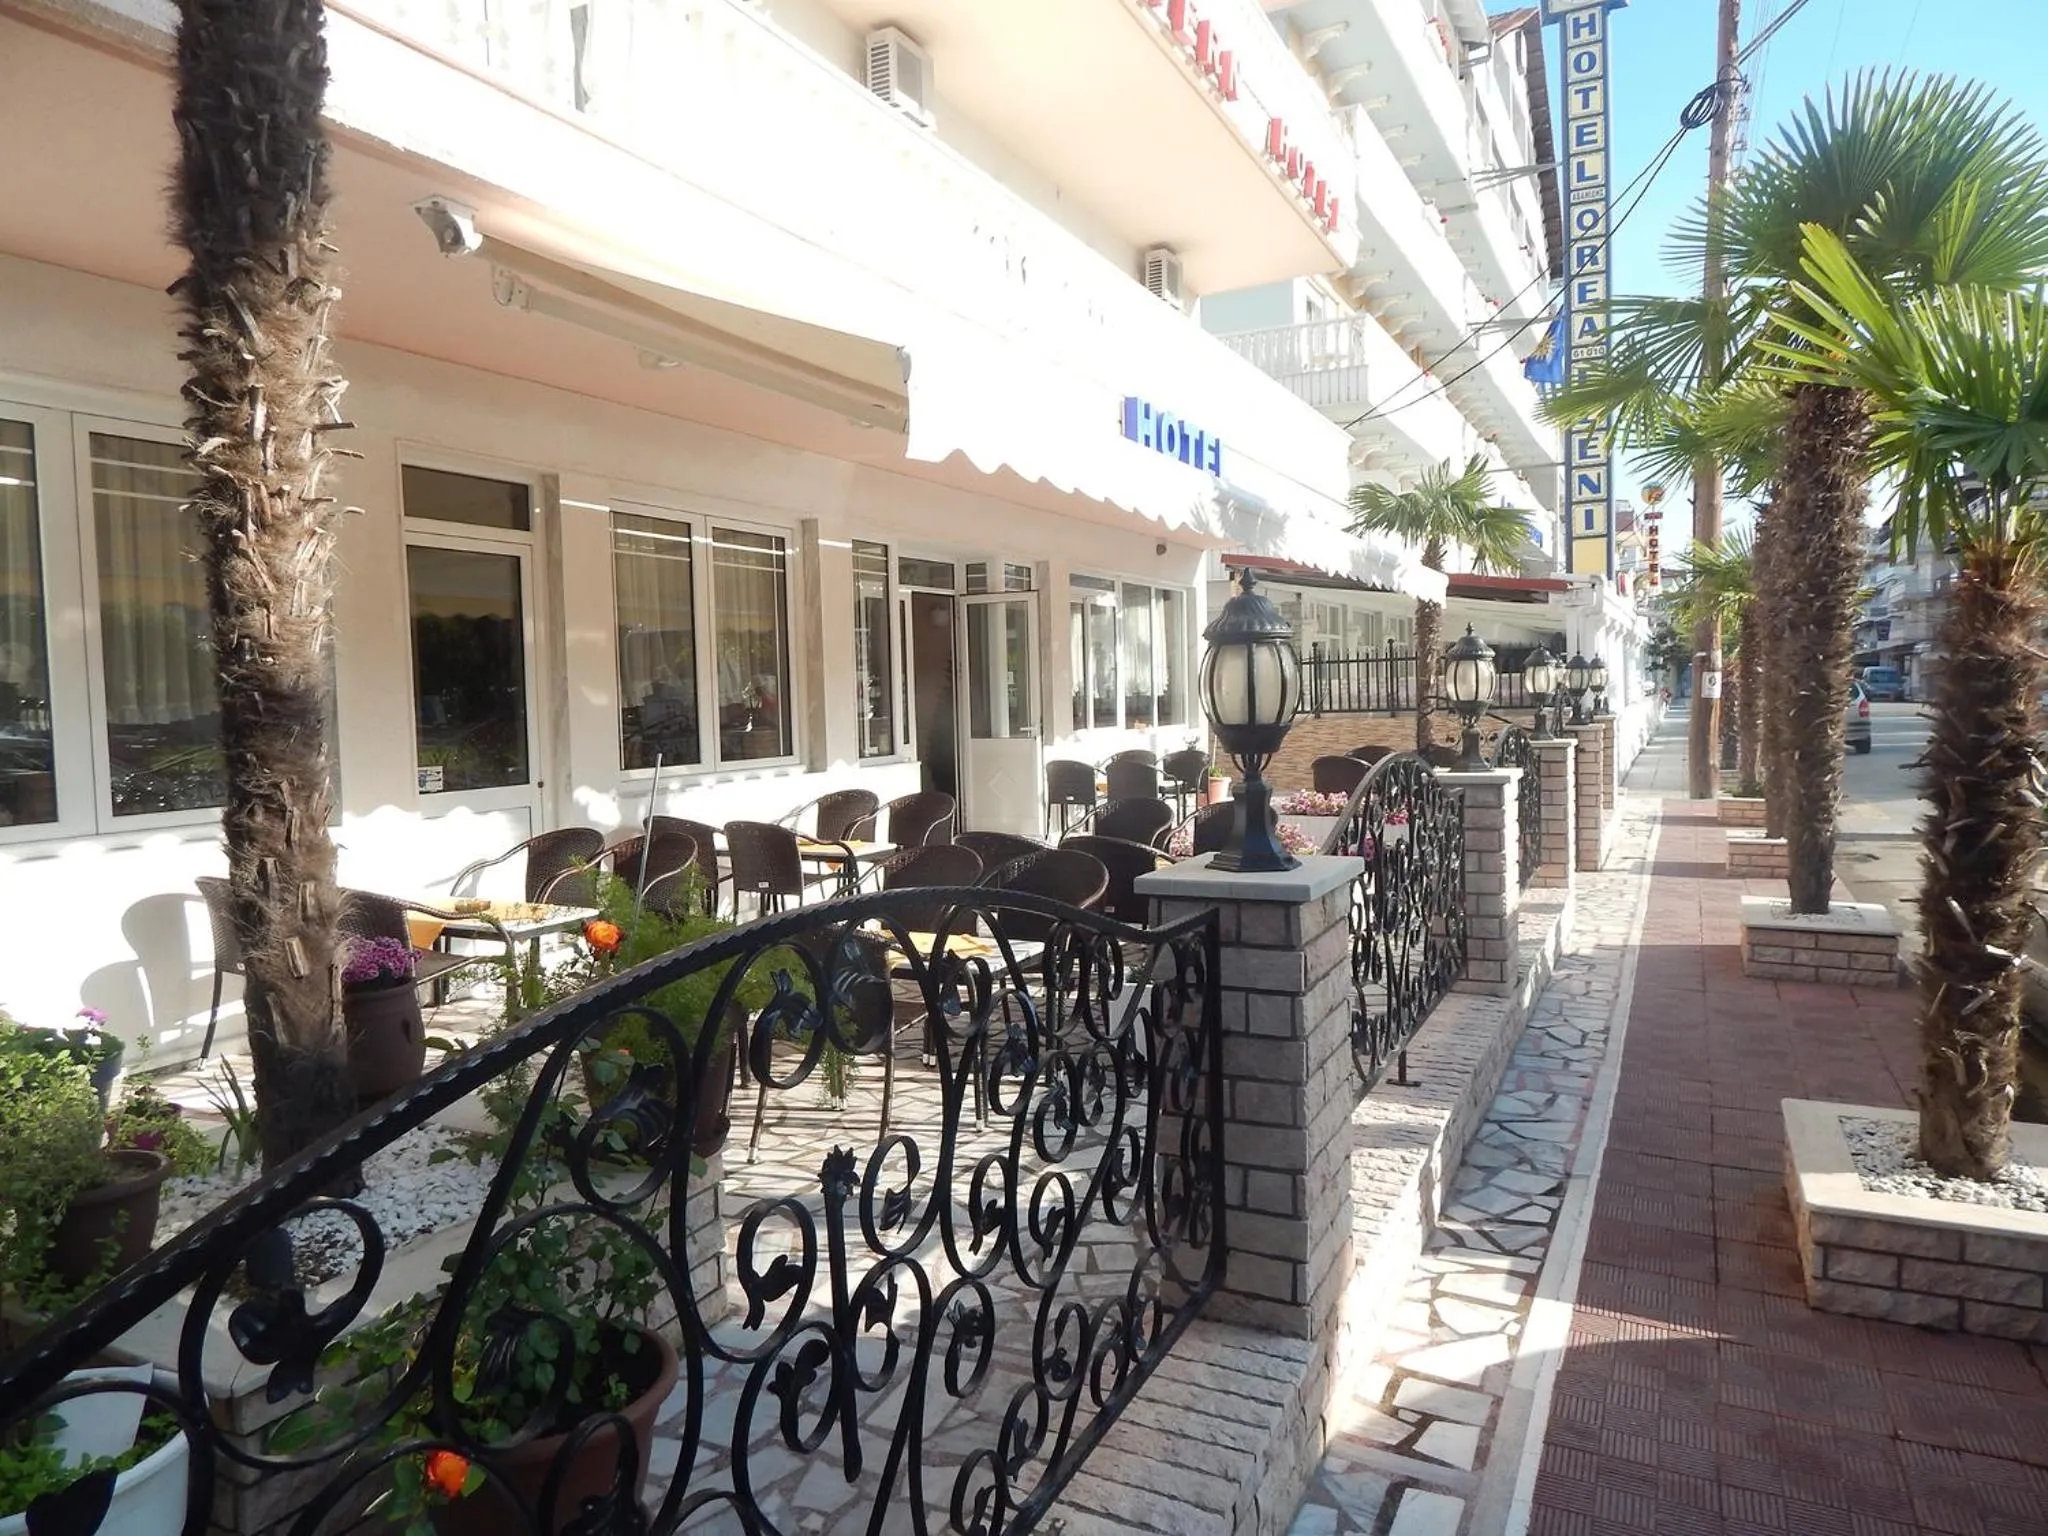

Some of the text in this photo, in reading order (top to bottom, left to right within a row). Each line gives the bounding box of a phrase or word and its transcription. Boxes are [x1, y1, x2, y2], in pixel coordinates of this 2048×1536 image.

[1572, 13, 1599, 183] HOTEL
[1576, 208, 1600, 339] OREA
[1650, 526, 1658, 585] HOTEL
